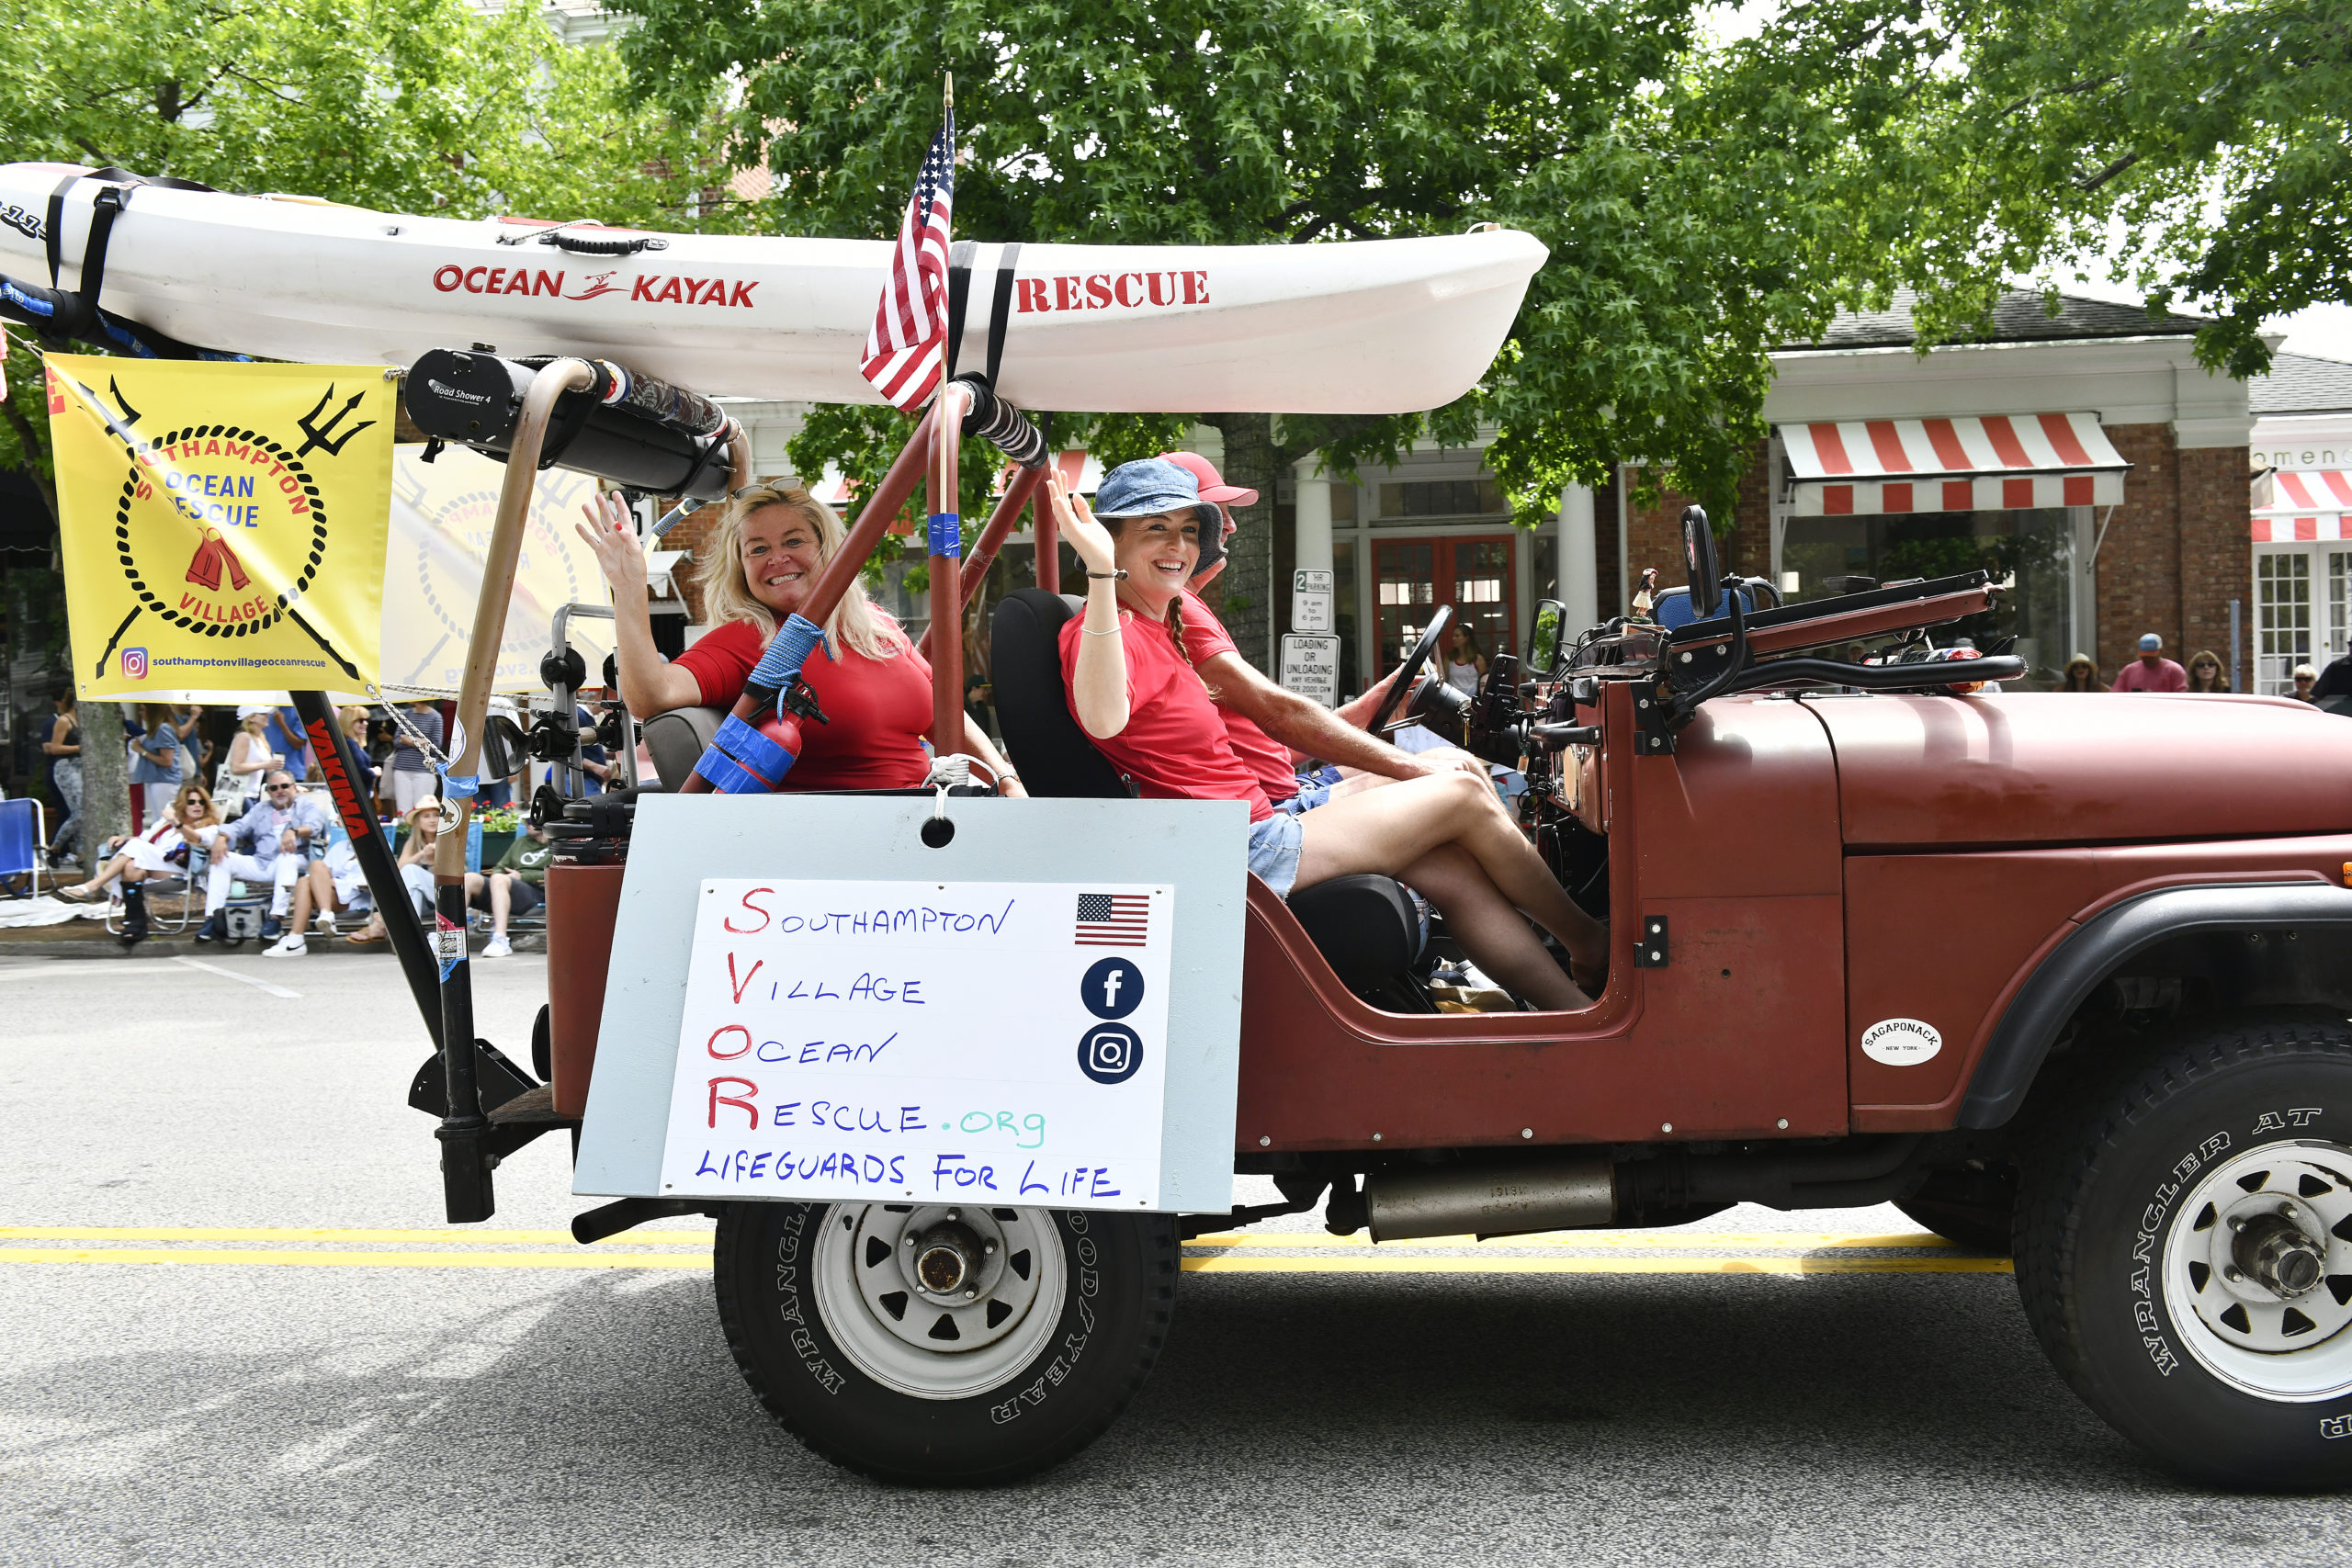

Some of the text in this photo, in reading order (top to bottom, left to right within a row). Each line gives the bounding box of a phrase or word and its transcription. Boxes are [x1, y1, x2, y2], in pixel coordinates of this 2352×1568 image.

[433, 265, 761, 308] OCEAN KAYAK
[1015, 270, 1210, 313] RESCUE
[434, 386, 456, 397] Road
[456, 389, 485, 403] Shower
[485, 395, 492, 404] 4
[165, 470, 254, 498] OCEAN
[167, 496, 259, 528] ESCUE
[1296, 574, 1306, 590] 2
[1306, 582, 1330, 592] PARKING
[179, 591, 269, 624] VILLAGE
[1293, 638, 1329, 650] LOADING
[1304, 651, 1316, 662] OR
[152, 656, 326, 669] southamptonvillageoceanrescue
[1286, 664, 1333, 675] UNLOADING
[305, 716, 369, 840] YAKIMA
[724, 887, 1015, 935] SOUTHAMPTON
[727, 952, 925, 1005] VILLAGE
[707, 1024, 899, 1065] OCEAN
[1864, 1022, 1939, 1047] SAGAPONACK
[695, 1150, 1121, 1198] LIFEGUARDS FOR LIFE
[2131, 1107, 2323, 1376] WRANGLER AT
[777, 1202, 845, 1395] WRANGL
